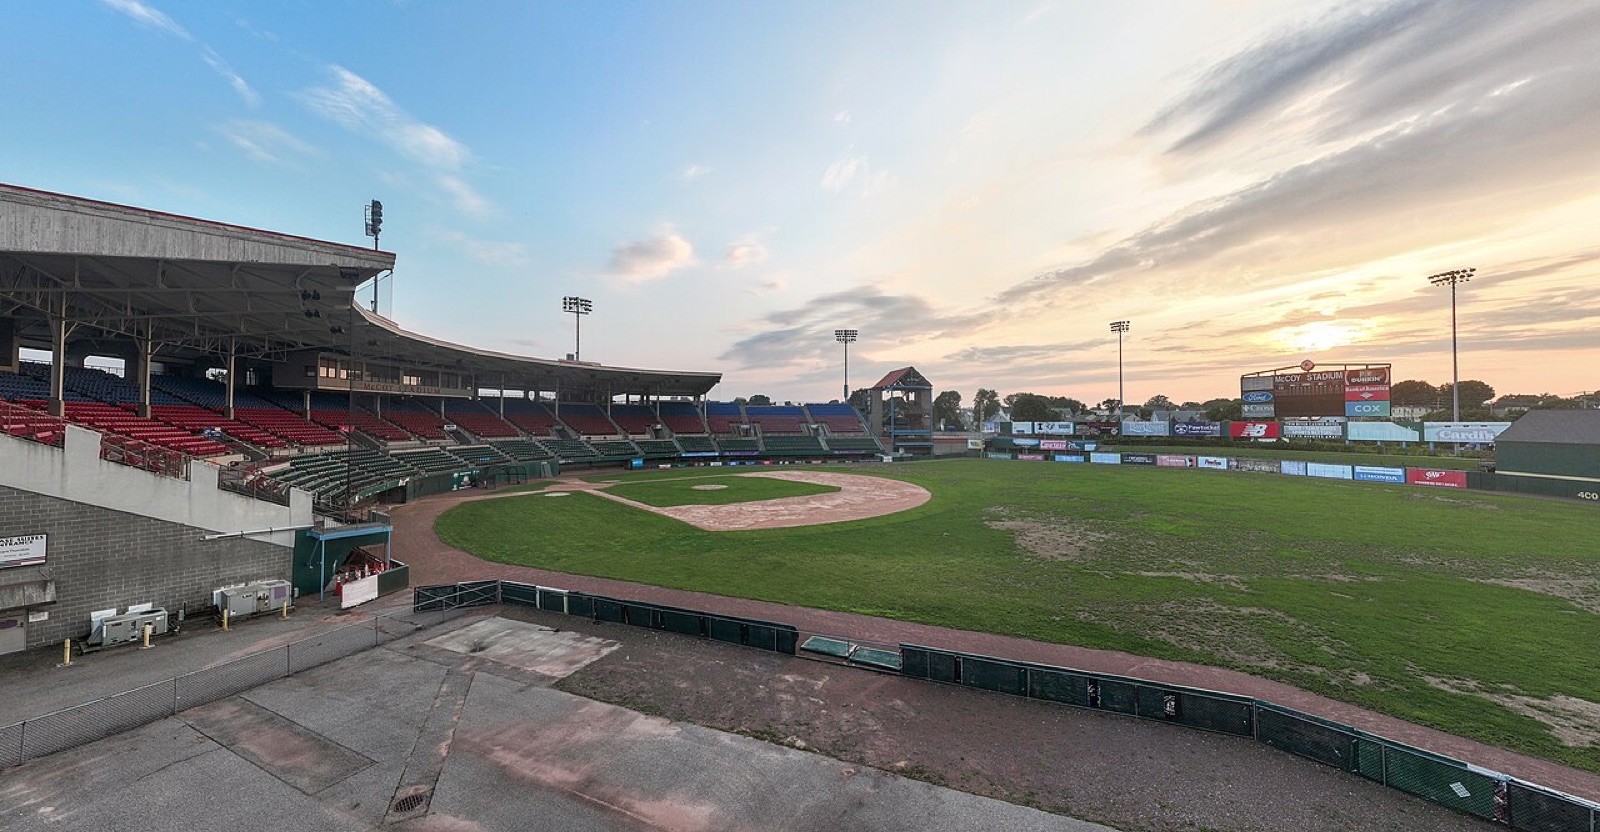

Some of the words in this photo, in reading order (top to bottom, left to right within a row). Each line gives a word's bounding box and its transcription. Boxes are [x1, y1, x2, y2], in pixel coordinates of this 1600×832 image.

[1274, 374, 1301, 382] McCOY
[1306, 371, 1344, 381] STADIUM
[1354, 404, 1381, 412] COX
